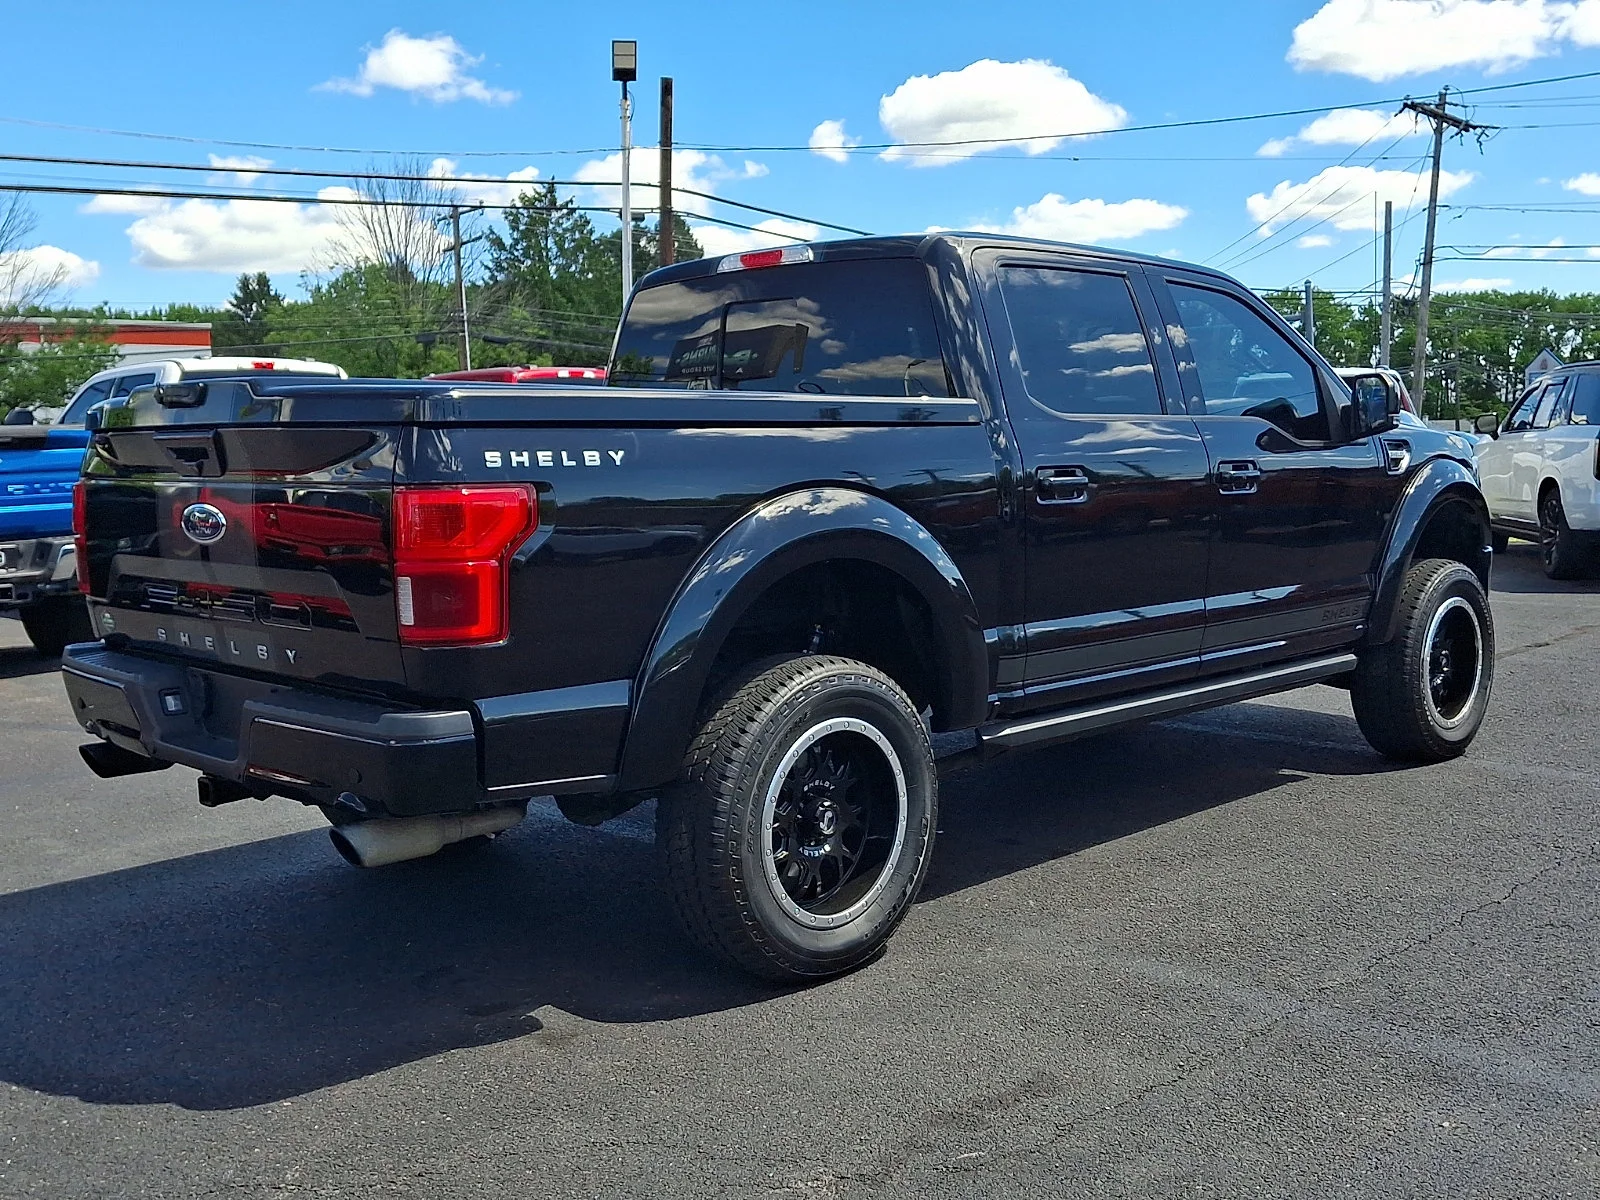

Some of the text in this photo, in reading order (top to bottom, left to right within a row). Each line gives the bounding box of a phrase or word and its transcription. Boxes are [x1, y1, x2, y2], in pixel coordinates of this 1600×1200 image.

[484, 450, 625, 468] SHELBY
[157, 627, 296, 665] SHELBY
[803, 779, 836, 792] SHELBY
